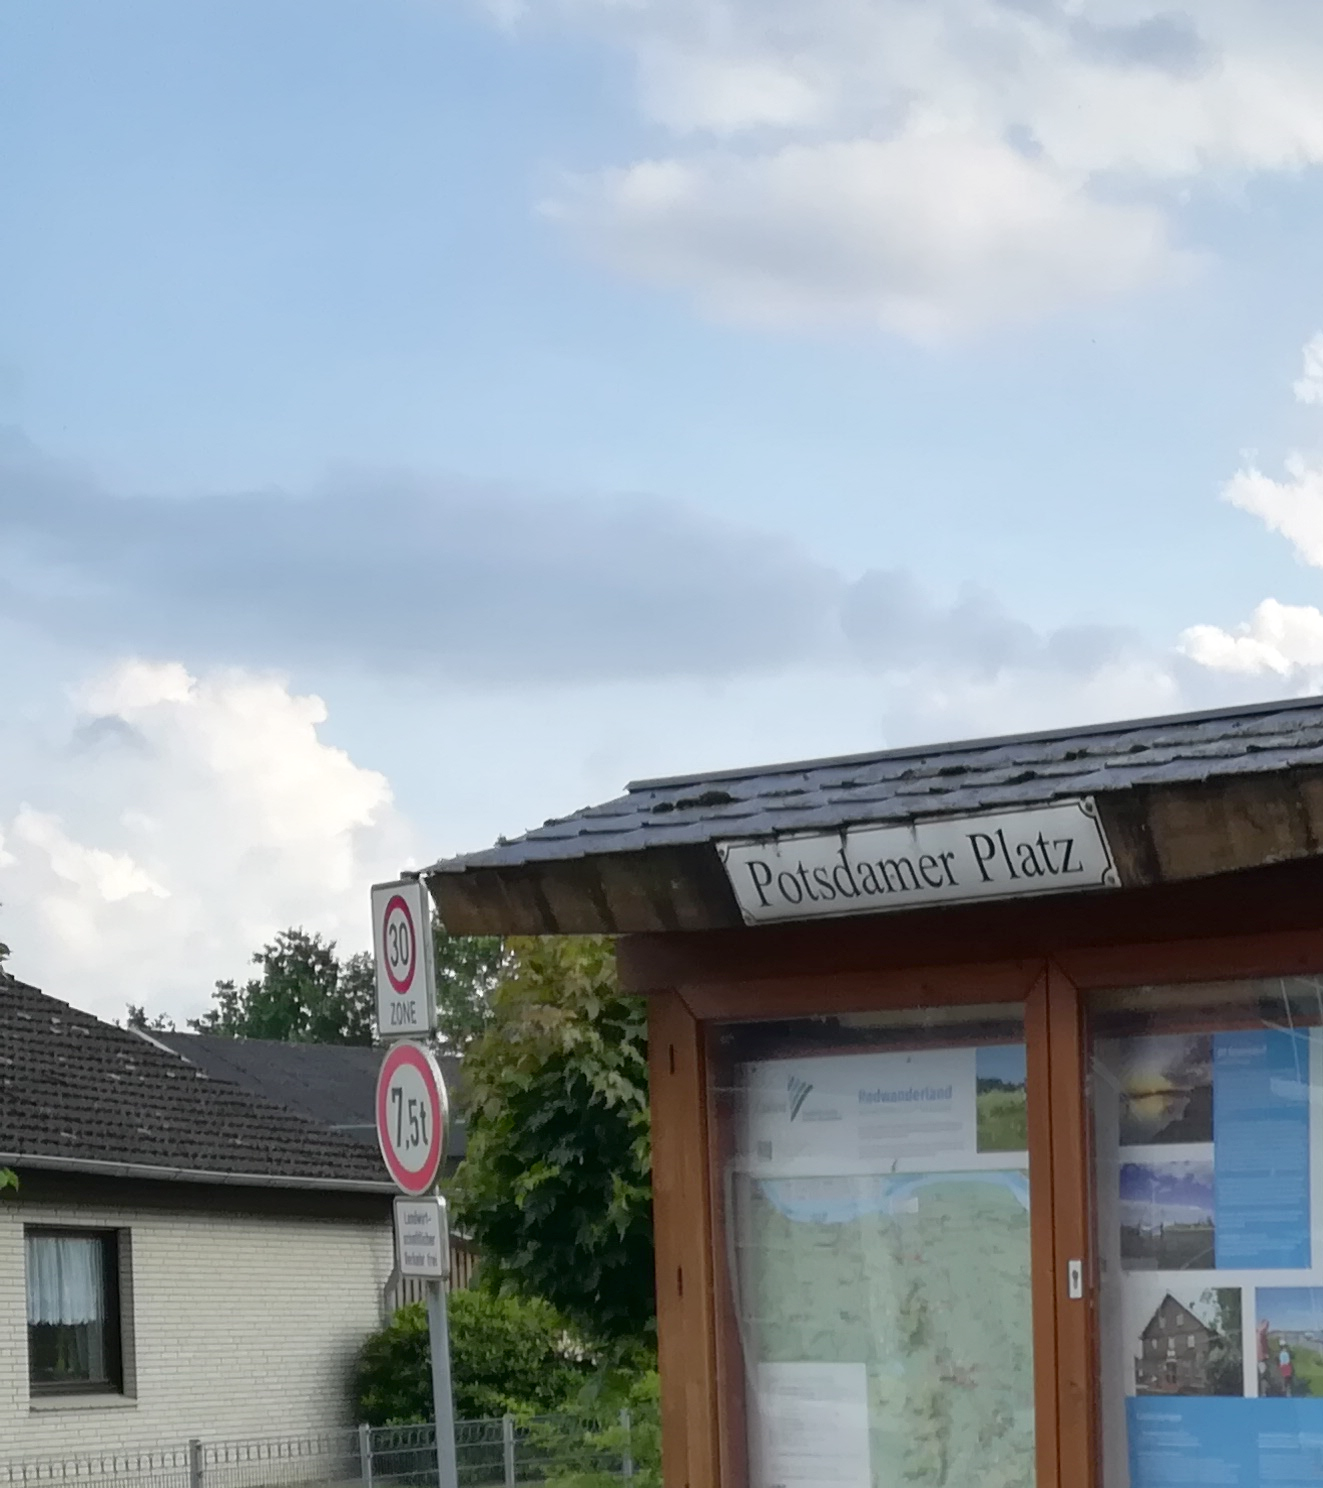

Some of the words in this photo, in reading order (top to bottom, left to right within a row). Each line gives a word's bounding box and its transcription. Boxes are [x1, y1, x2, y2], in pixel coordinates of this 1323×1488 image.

[745, 849, 960, 908] Potsdamer
[966, 828, 1085, 883] Platz
[389, 922, 409, 967] 30
[390, 1000, 417, 1026] ZONE
[391, 1087, 428, 1150] 7,5t
